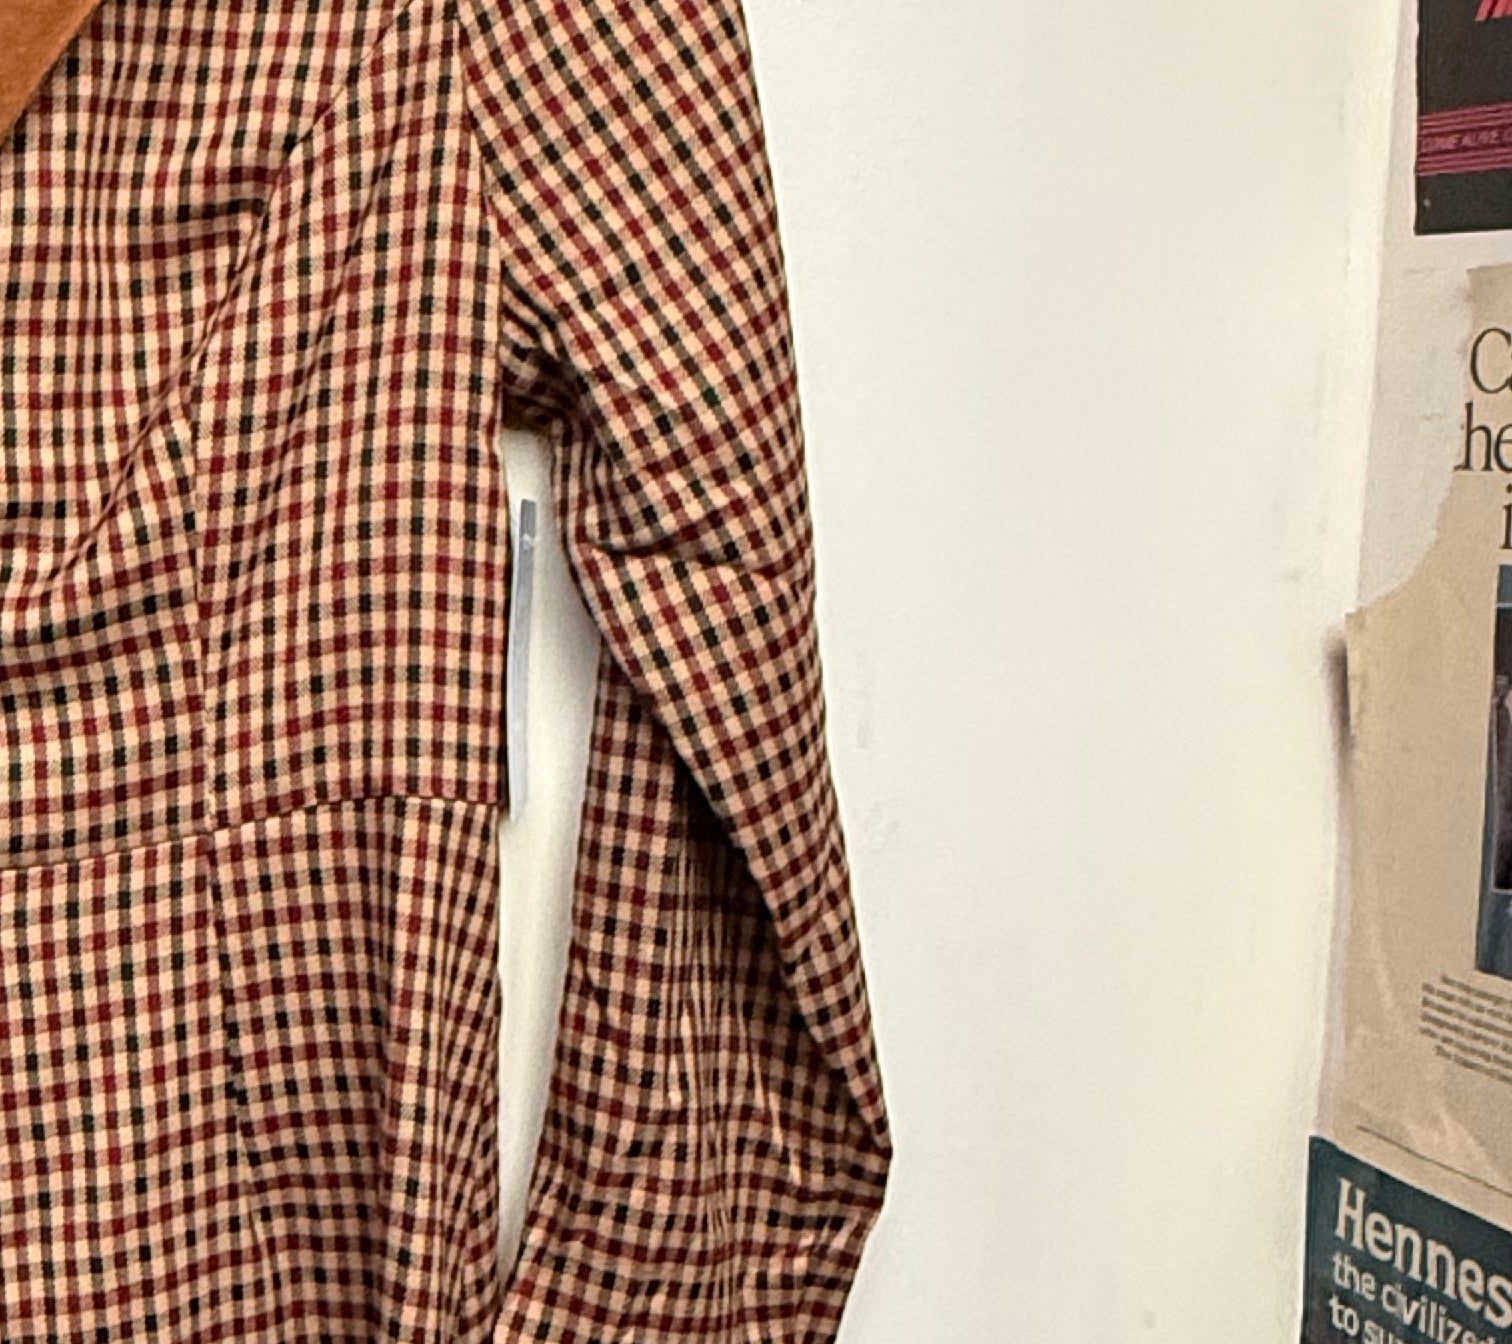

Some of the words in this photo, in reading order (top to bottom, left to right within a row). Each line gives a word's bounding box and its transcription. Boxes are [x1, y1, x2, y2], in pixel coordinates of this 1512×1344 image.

[1332, 1252, 1377, 1302] the
[1334, 1175, 1512, 1329] Hennes
[1328, 1294, 1360, 1337] to
